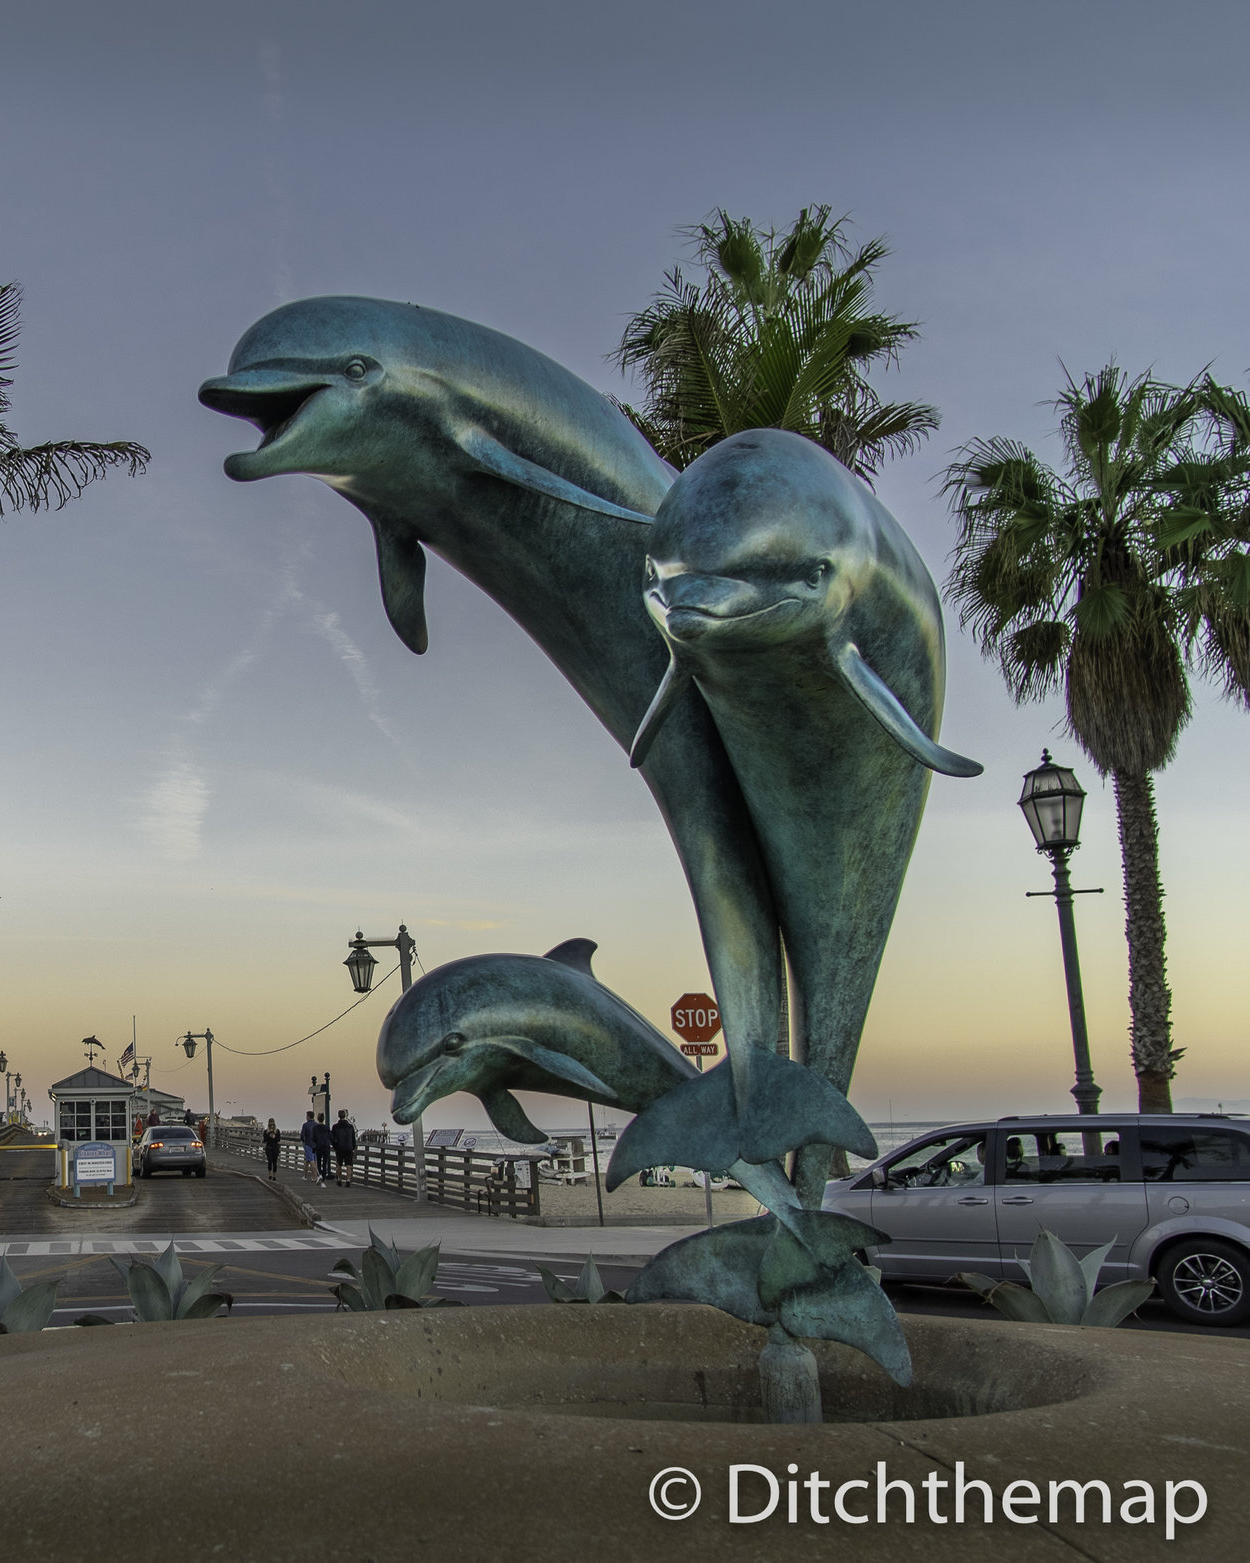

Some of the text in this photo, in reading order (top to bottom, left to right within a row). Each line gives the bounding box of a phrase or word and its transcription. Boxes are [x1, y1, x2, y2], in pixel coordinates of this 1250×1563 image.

[675, 1008, 718, 1028] STOP
[683, 1046, 715, 1054] ALL WAY
